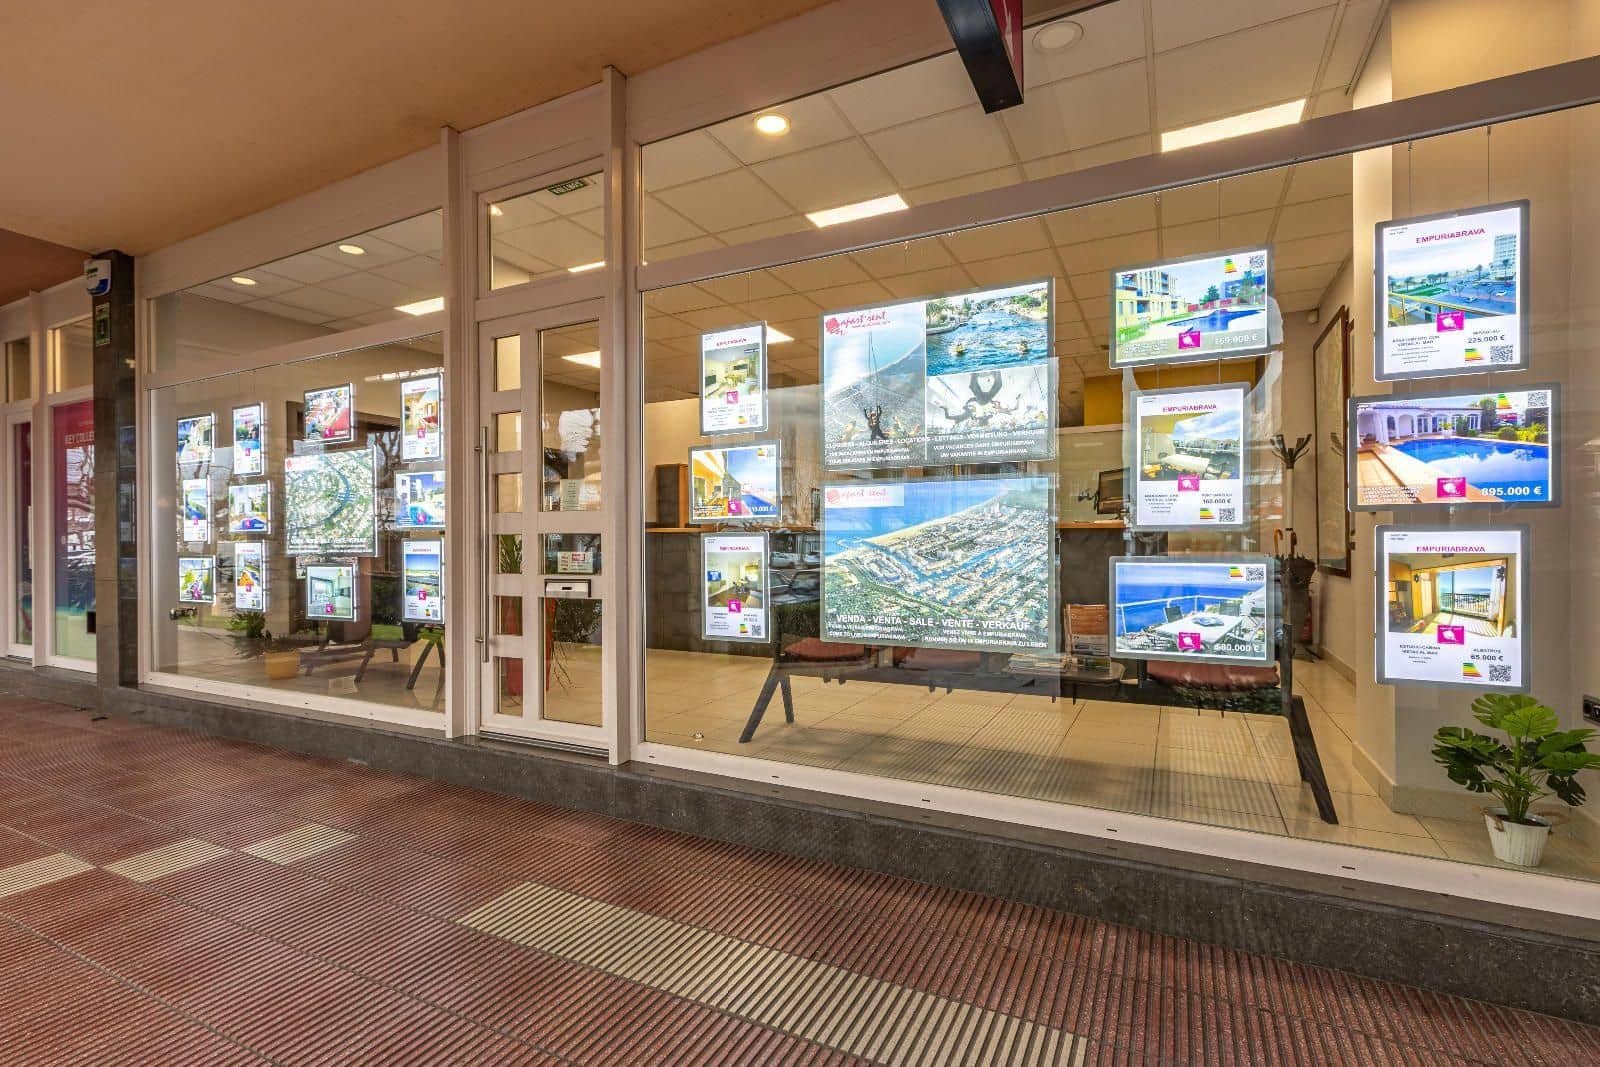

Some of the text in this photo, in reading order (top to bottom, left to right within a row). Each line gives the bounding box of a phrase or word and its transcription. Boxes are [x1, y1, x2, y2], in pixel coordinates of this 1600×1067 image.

[1416, 228, 1486, 244] EMPURIABRAVA
[1468, 336, 1498, 344] 225.000
[1163, 403, 1217, 413] EMPURIABRAVA
[1481, 486, 1542, 496] 895.000 €
[836, 614, 866, 624] VENDA
[872, 615, 902, 625] VENTA
[909, 617, 934, 626] SALE
[941, 619, 975, 628] VENTE
[982, 620, 1032, 630] VERKAUF
